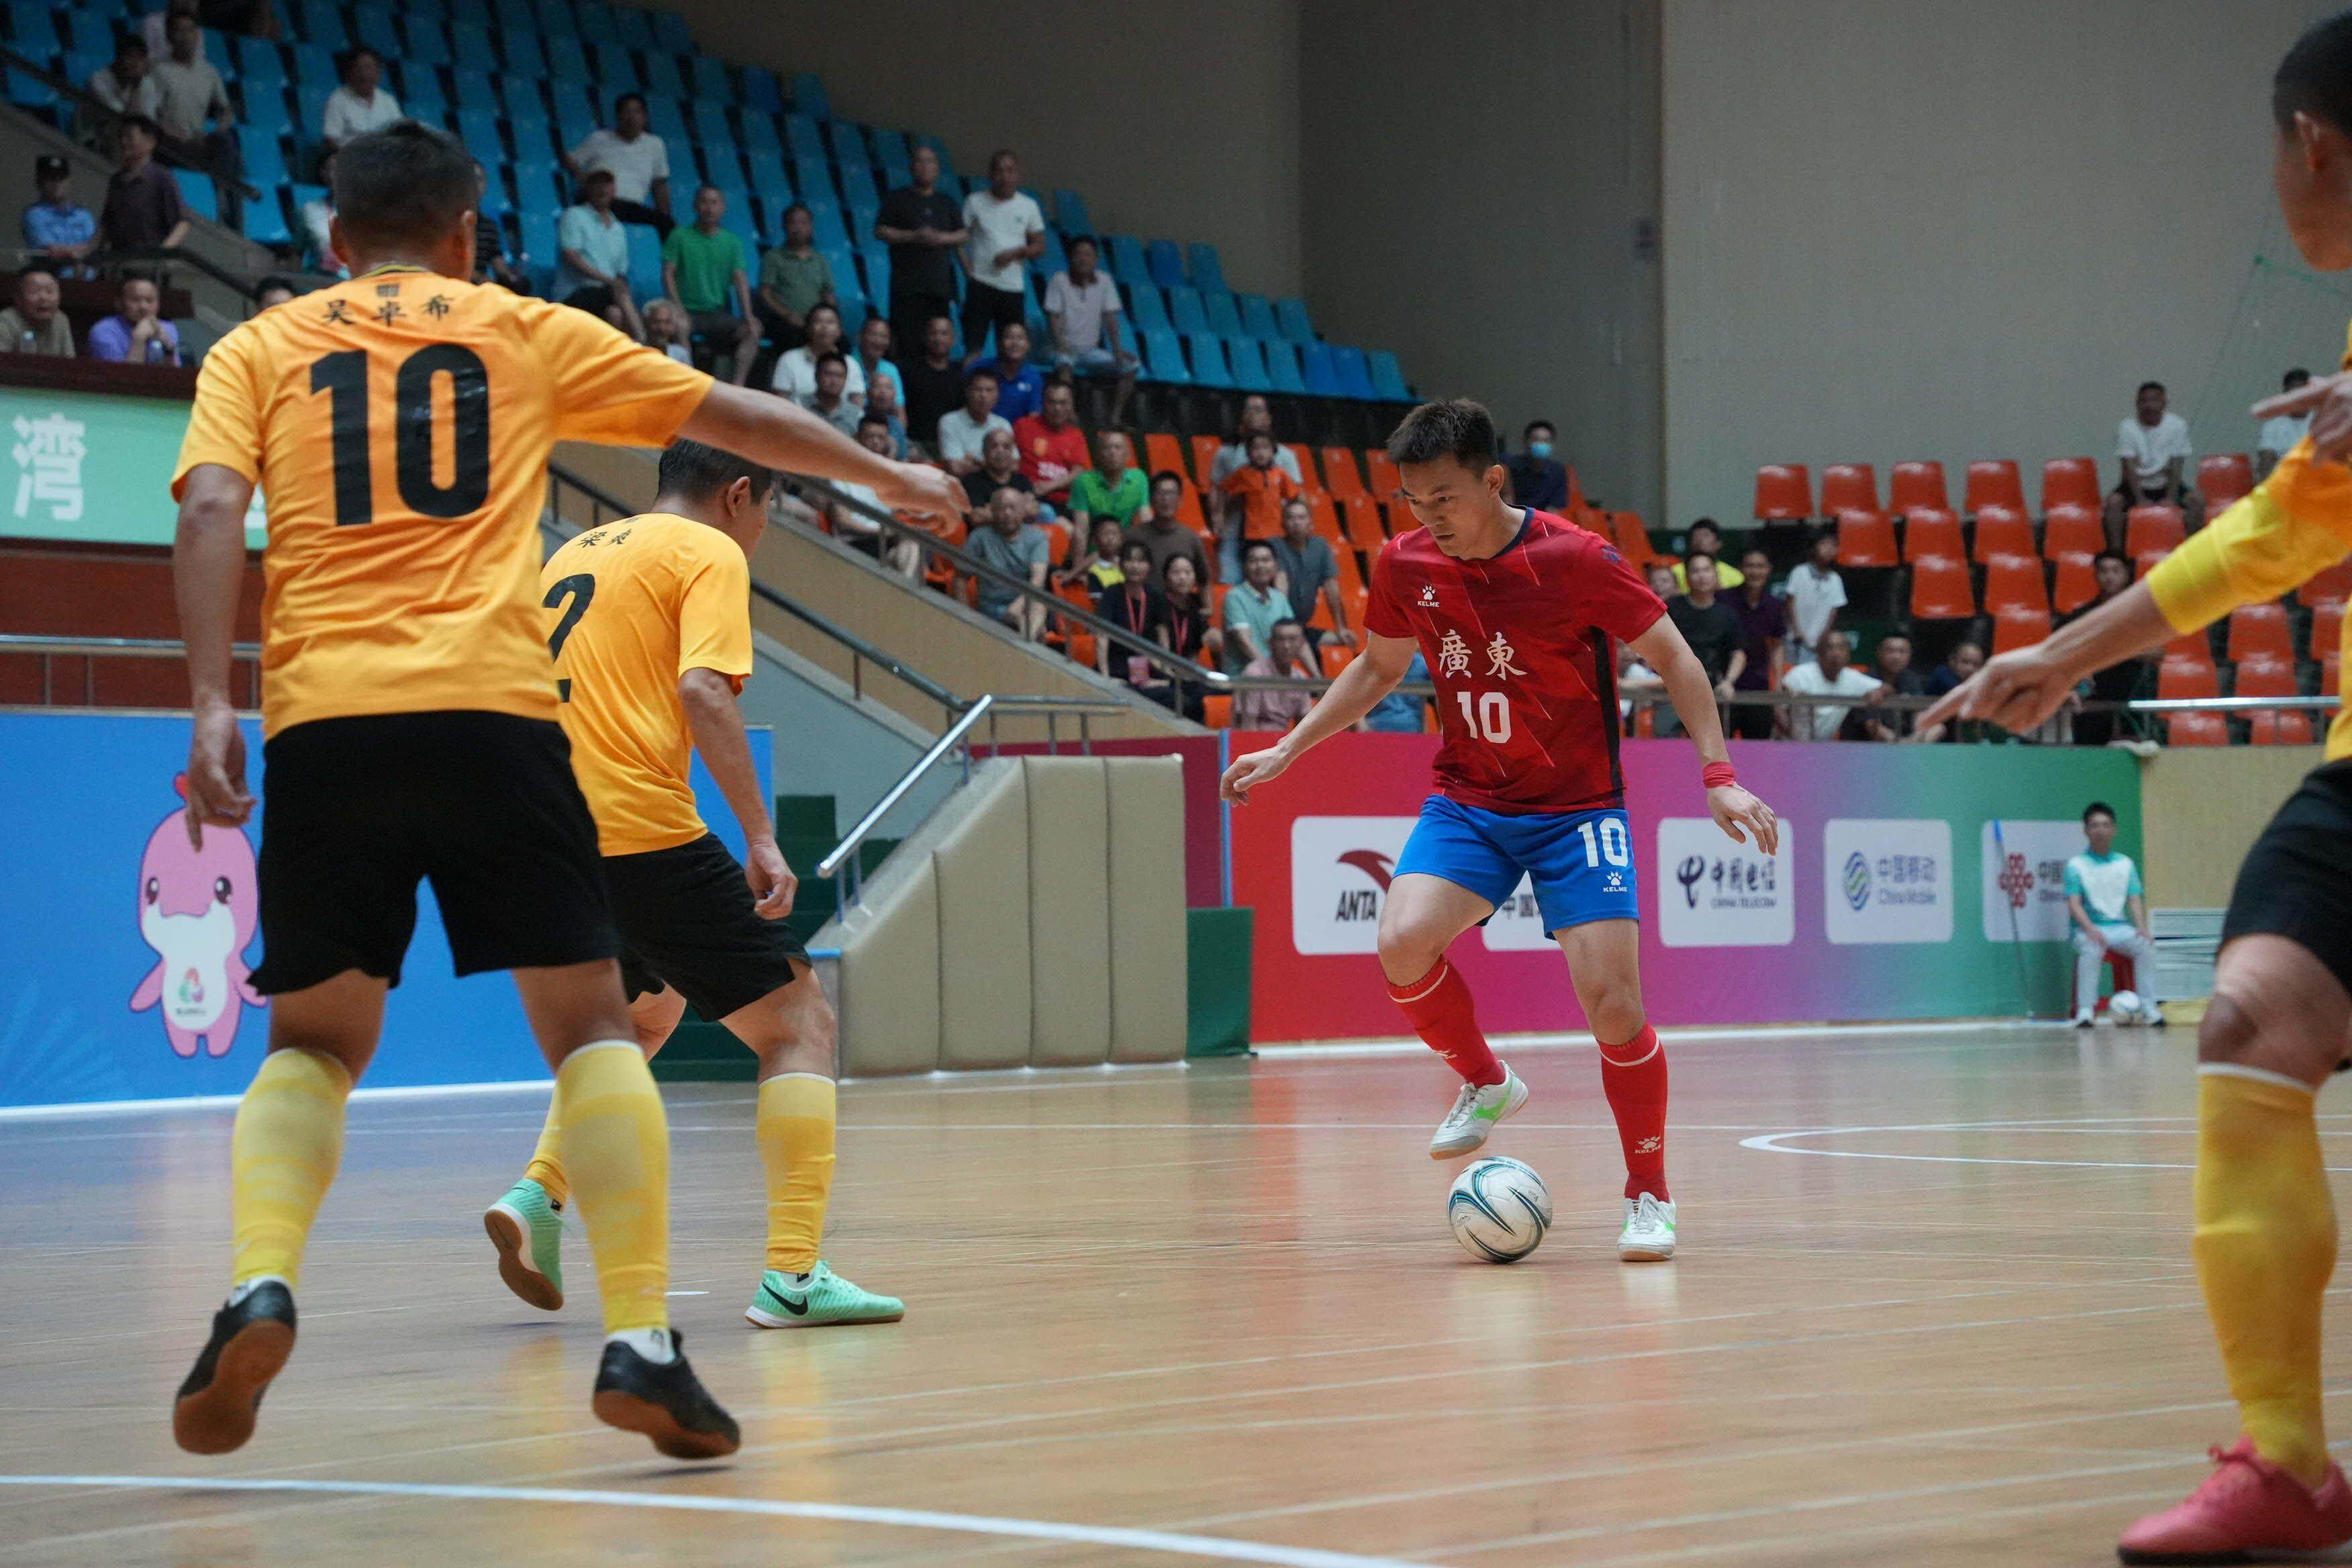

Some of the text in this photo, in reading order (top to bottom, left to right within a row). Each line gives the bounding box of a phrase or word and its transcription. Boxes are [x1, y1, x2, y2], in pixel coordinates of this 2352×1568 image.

[310, 343, 489, 526] 10
[11, 412, 87, 522] 湾
[542, 573, 596, 703] 2
[1438, 629, 1527, 681] 廣東
[1457, 691, 1511, 744] 10
[1577, 818, 1628, 868] 10
[1335, 890, 1376, 922] ANTA
